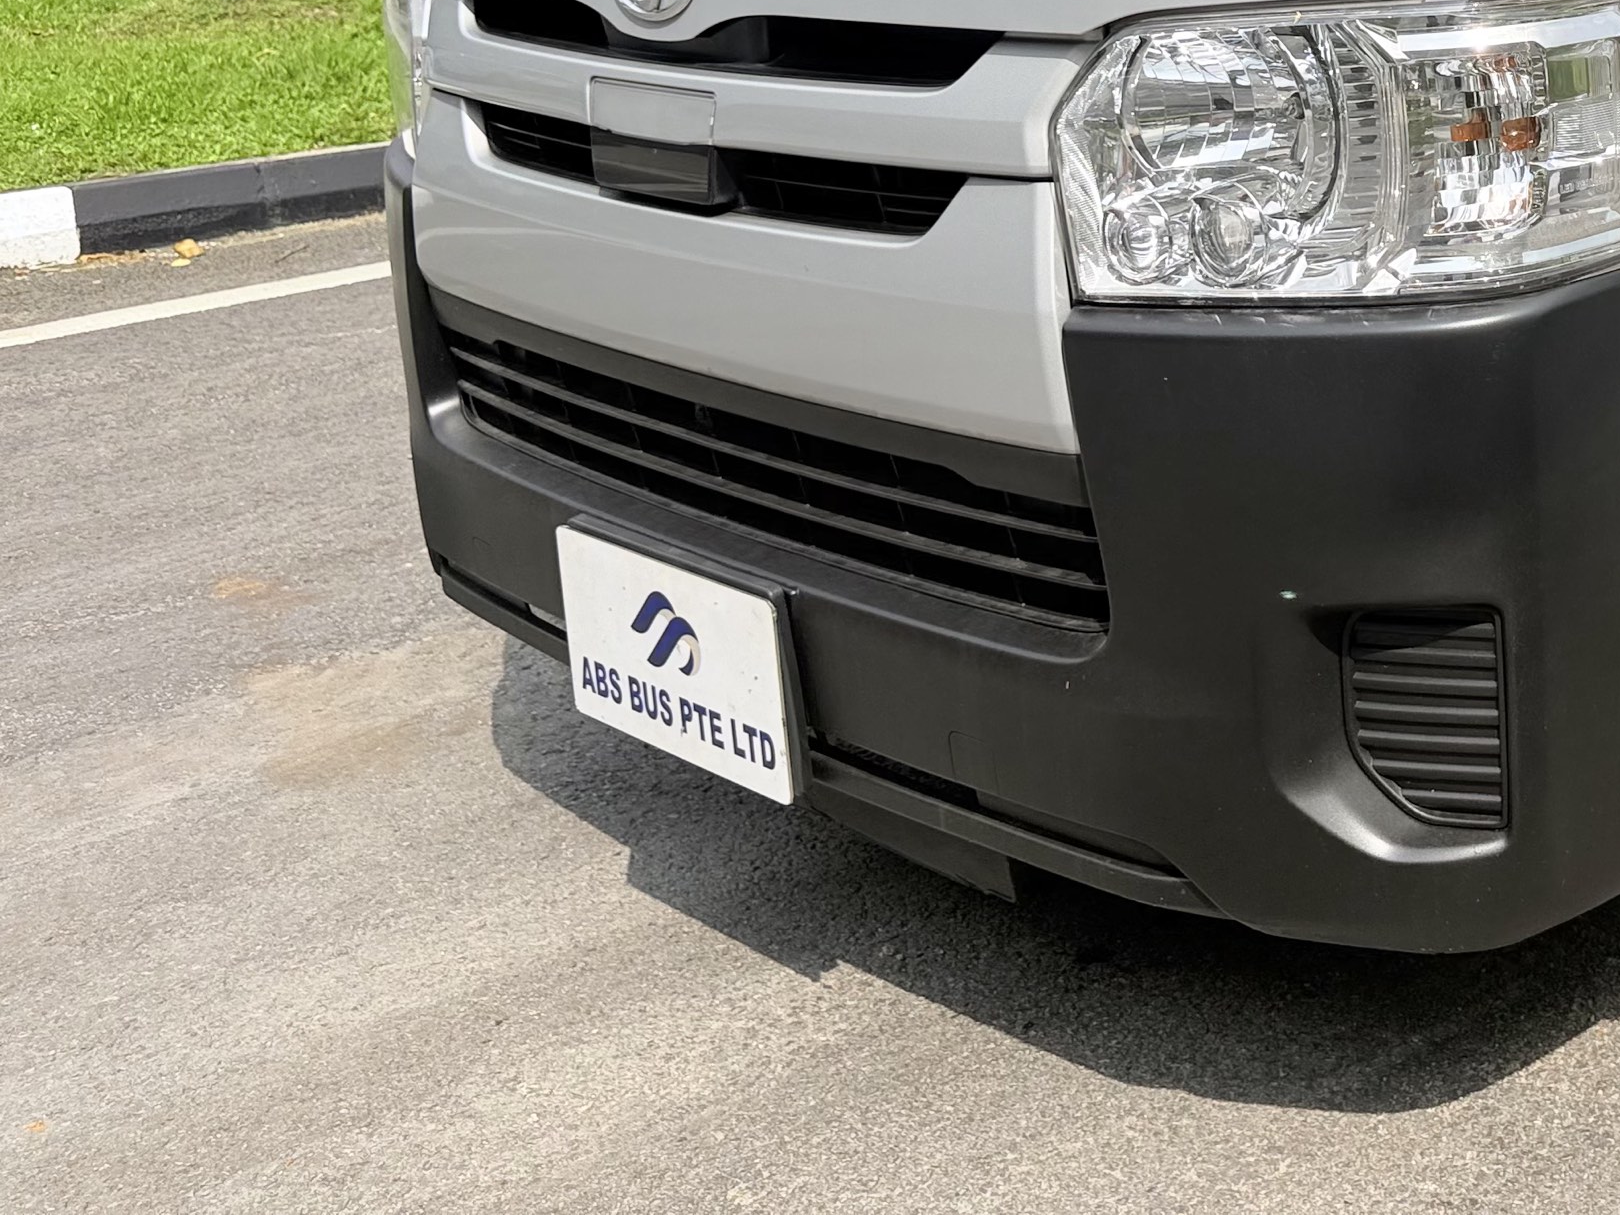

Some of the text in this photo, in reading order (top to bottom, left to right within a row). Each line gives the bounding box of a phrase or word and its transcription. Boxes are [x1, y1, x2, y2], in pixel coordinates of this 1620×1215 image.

[582, 656, 776, 771] ABS BUS PTE LTD
